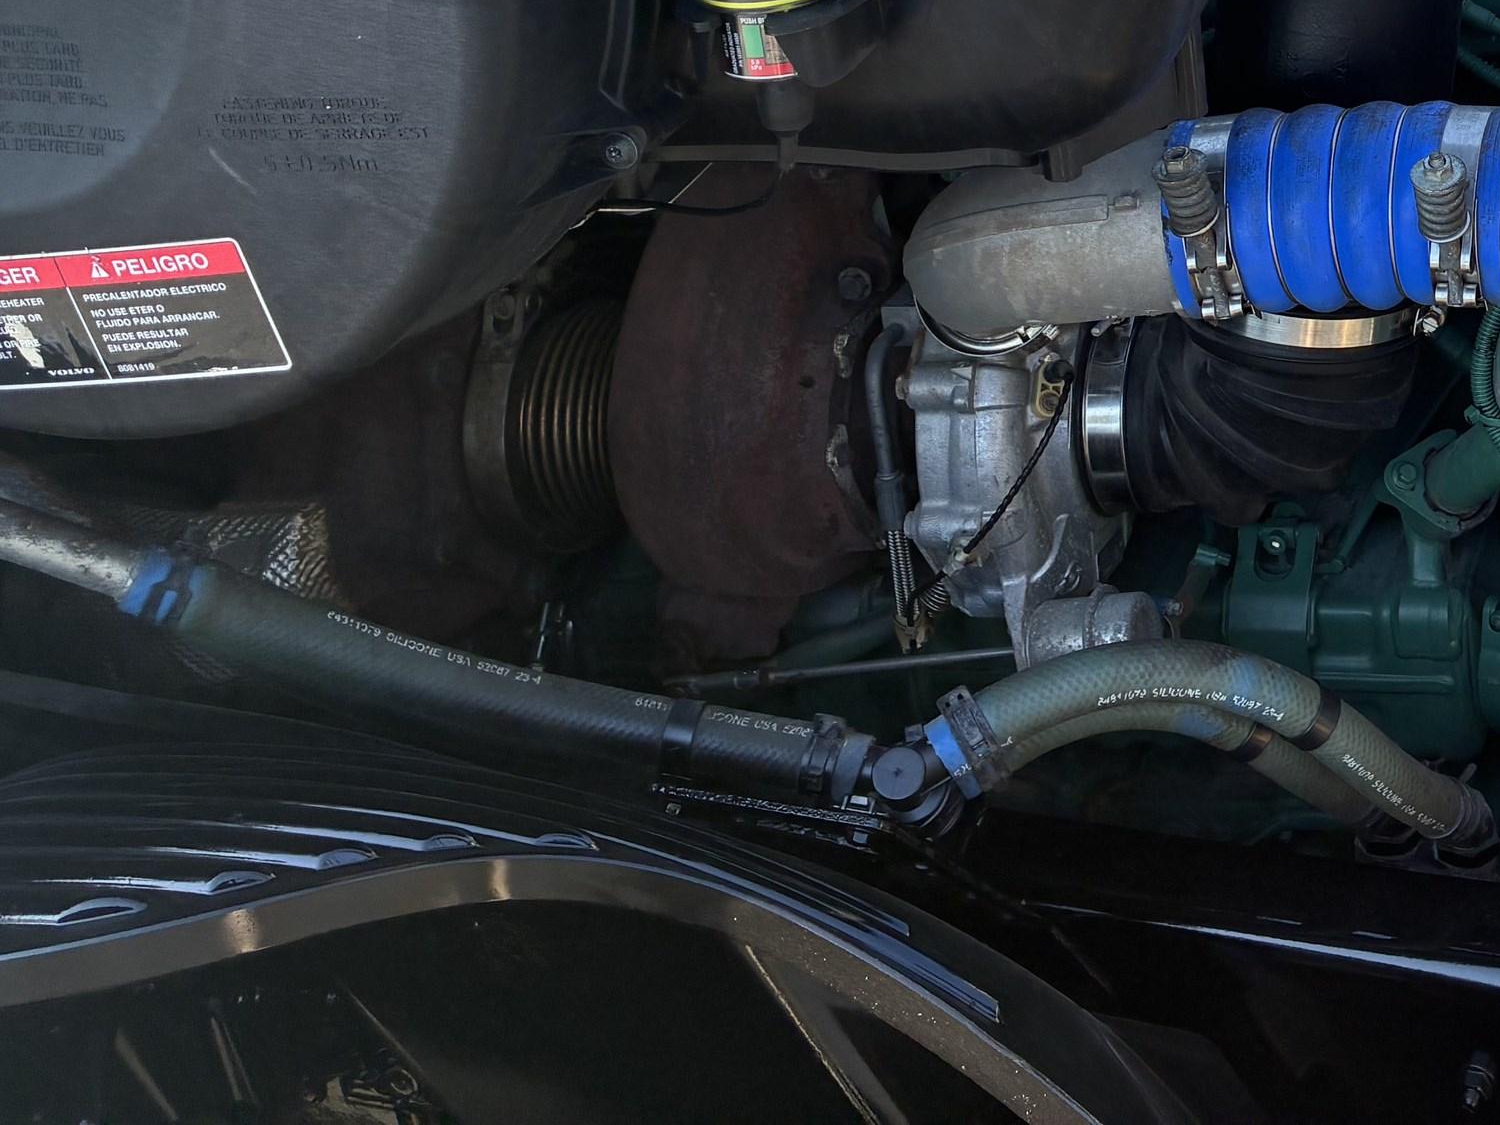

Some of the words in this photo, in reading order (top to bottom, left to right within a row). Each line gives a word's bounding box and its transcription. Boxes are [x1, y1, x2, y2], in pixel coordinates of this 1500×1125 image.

[111, 253, 209, 277] PELIGRO
[82, 287, 169, 302] PRECALENTADOR
[169, 282, 227, 296] ELECTRICO
[27, 313, 43, 323] OR
[90, 308, 106, 318] NO
[108, 307, 129, 317] USE
[130, 305, 155, 316] ETER
[155, 304, 165, 314] O
[95, 317, 132, 329] FLUIDO
[133, 315, 160, 326] PARA
[162, 311, 221, 324] ARRANCAR.
[102, 330, 136, 342] PUEDE
[137, 328, 189, 340] RESULTAR
[107, 343, 122, 353] EN
[124, 340, 182, 352] EXPLOSION.
[48, 367, 95, 376] VOLVO
[1152, 686, 1202, 699] SILICONE
